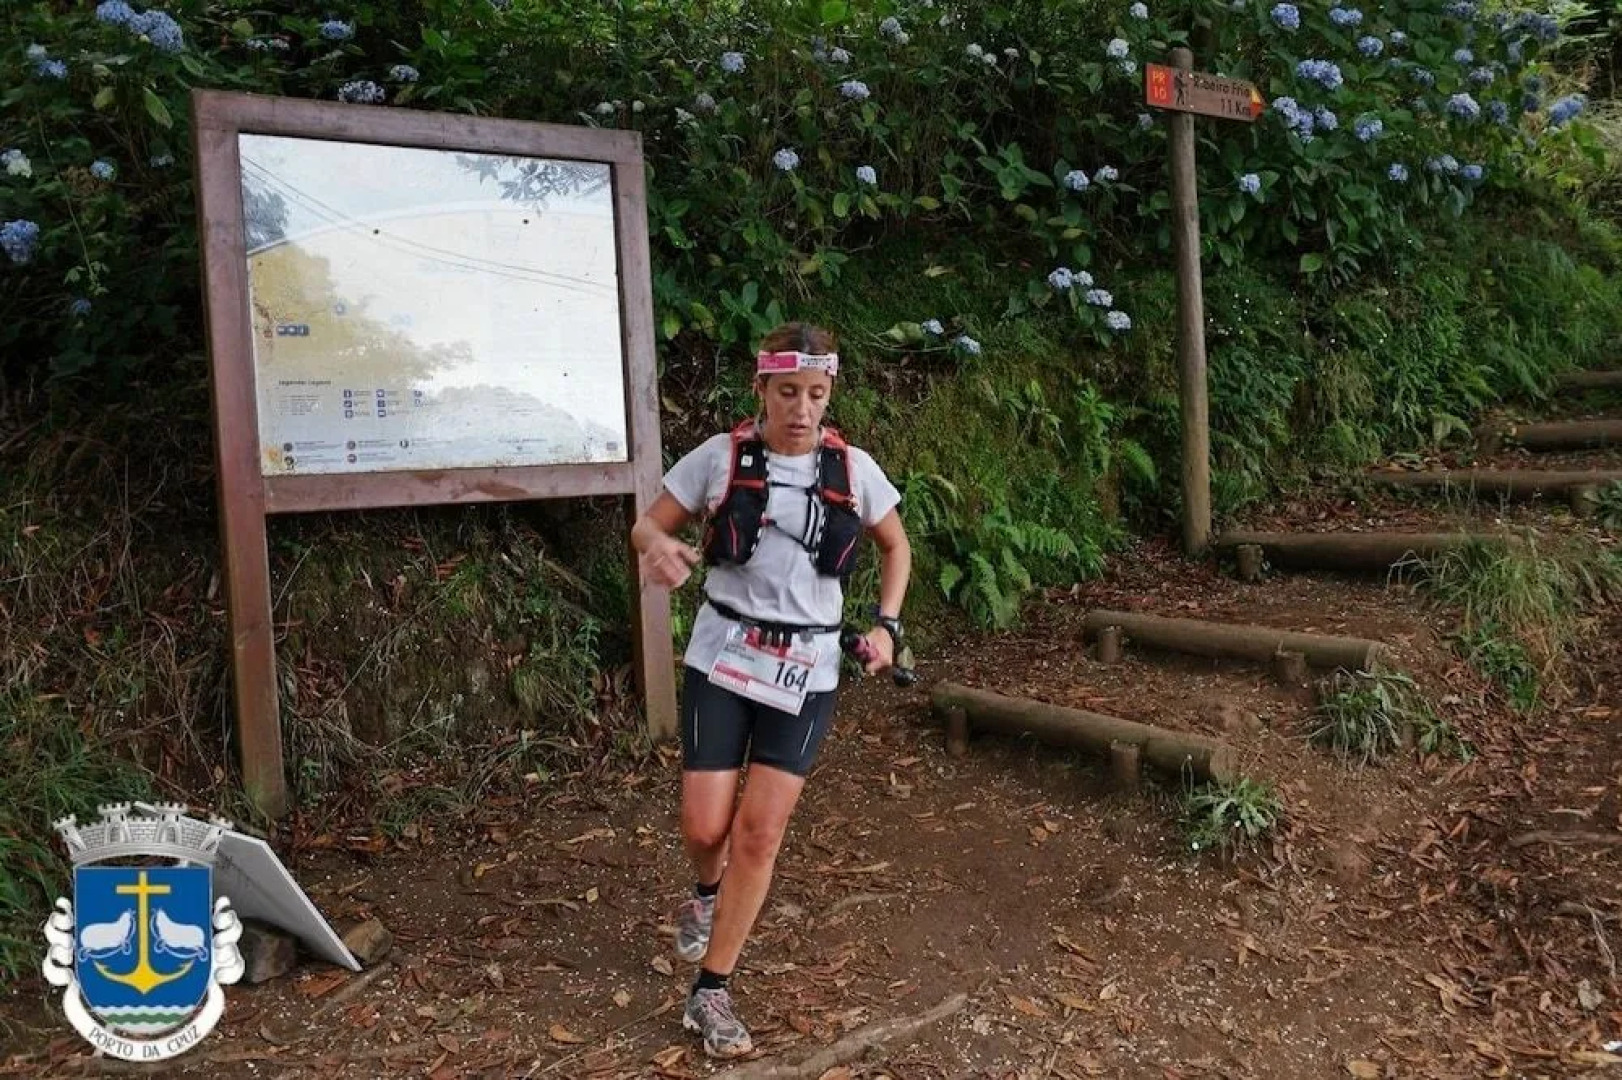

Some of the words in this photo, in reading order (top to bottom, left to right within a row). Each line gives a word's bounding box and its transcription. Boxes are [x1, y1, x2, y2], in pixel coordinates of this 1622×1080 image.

[1152, 70, 1165, 84] PR
[1153, 86, 1167, 99] 10
[1220, 98, 1232, 113] 11
[775, 661, 809, 692] 164
